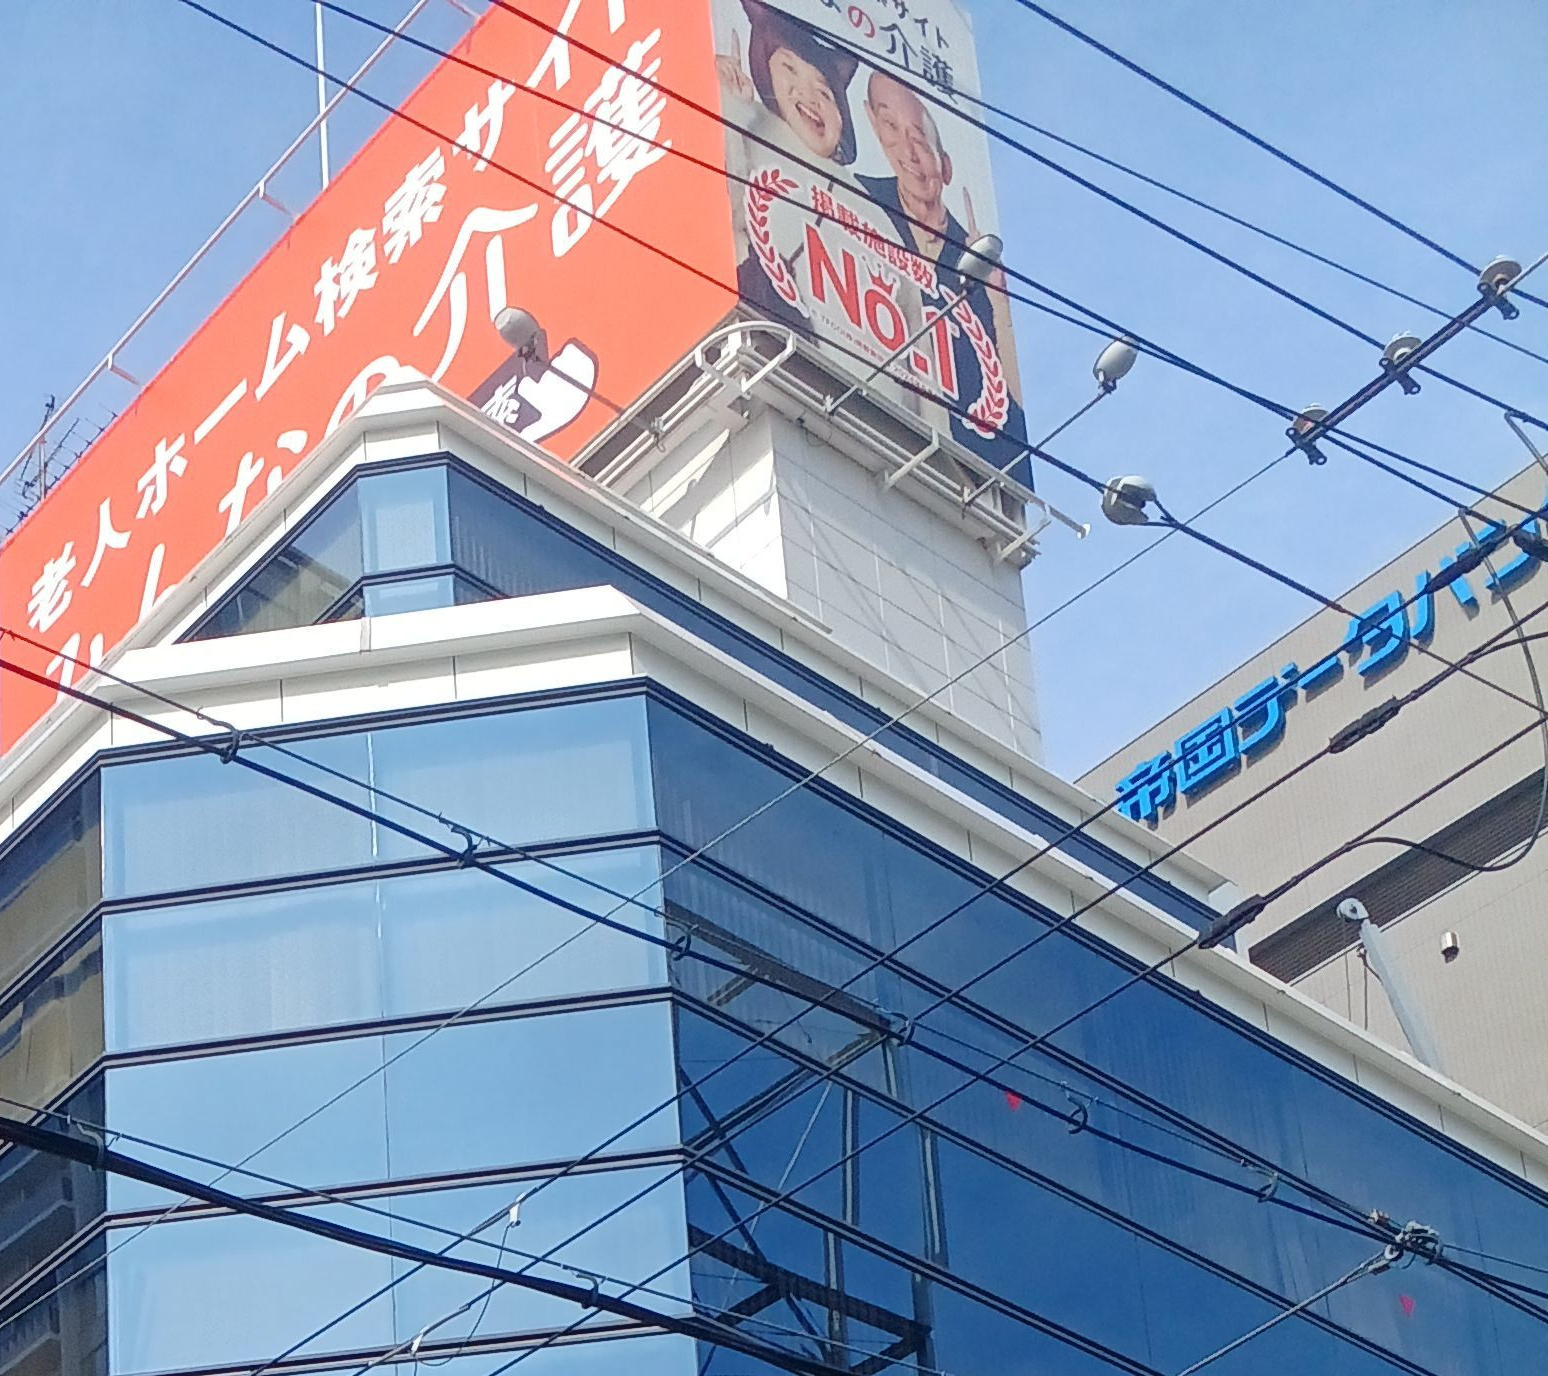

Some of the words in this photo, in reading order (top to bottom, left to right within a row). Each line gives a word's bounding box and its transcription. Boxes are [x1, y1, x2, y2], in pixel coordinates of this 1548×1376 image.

[27, 0, 625, 632] 老人ホーム検索サイ
[805, 222, 955, 396] No.1
[811, 184, 937, 295] 掲載施設数
[1114, 483, 1548, 822] 帝国データバン
